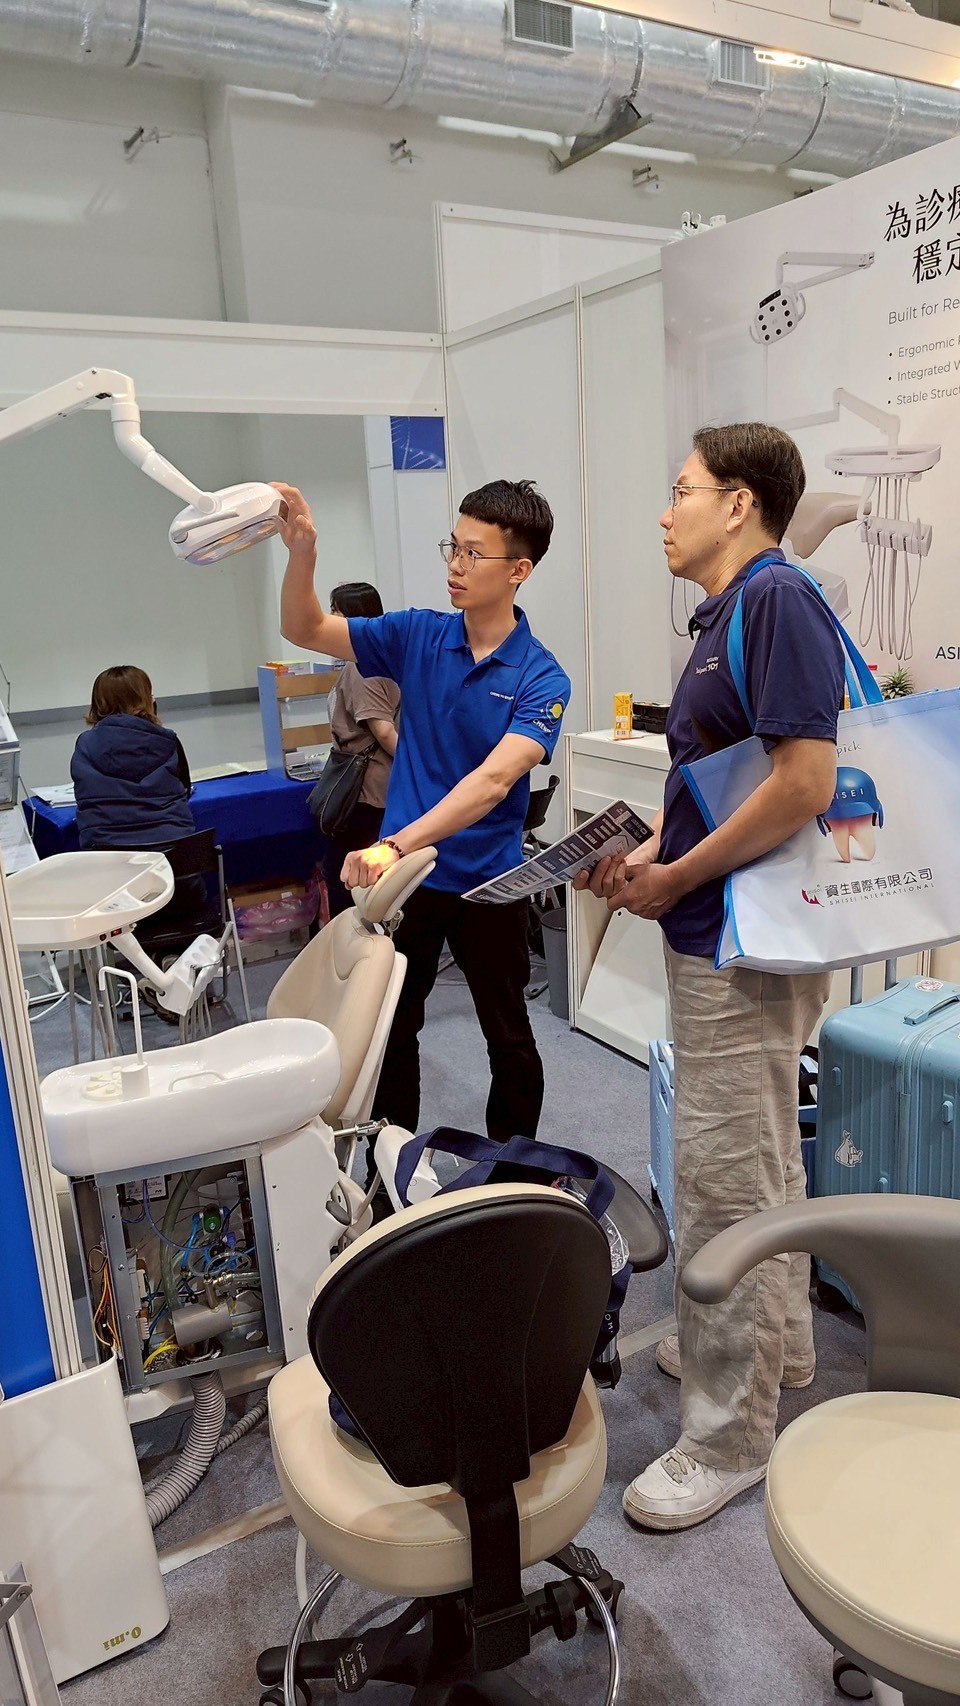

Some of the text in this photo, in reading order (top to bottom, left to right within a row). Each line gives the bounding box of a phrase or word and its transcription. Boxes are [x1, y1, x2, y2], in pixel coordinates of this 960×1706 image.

[889, 306, 917, 325] Built
[921, 303, 939, 317] for
[898, 338, 955, 358] Ergonomic
[897, 361, 951, 381] Integrated
[896, 391, 928, 405] Stable
[836, 741, 862, 758] pick
[825, 868, 934, 899] 資生國際有限公司
[829, 882, 935, 906] SHISEI INTERNATIONAL
